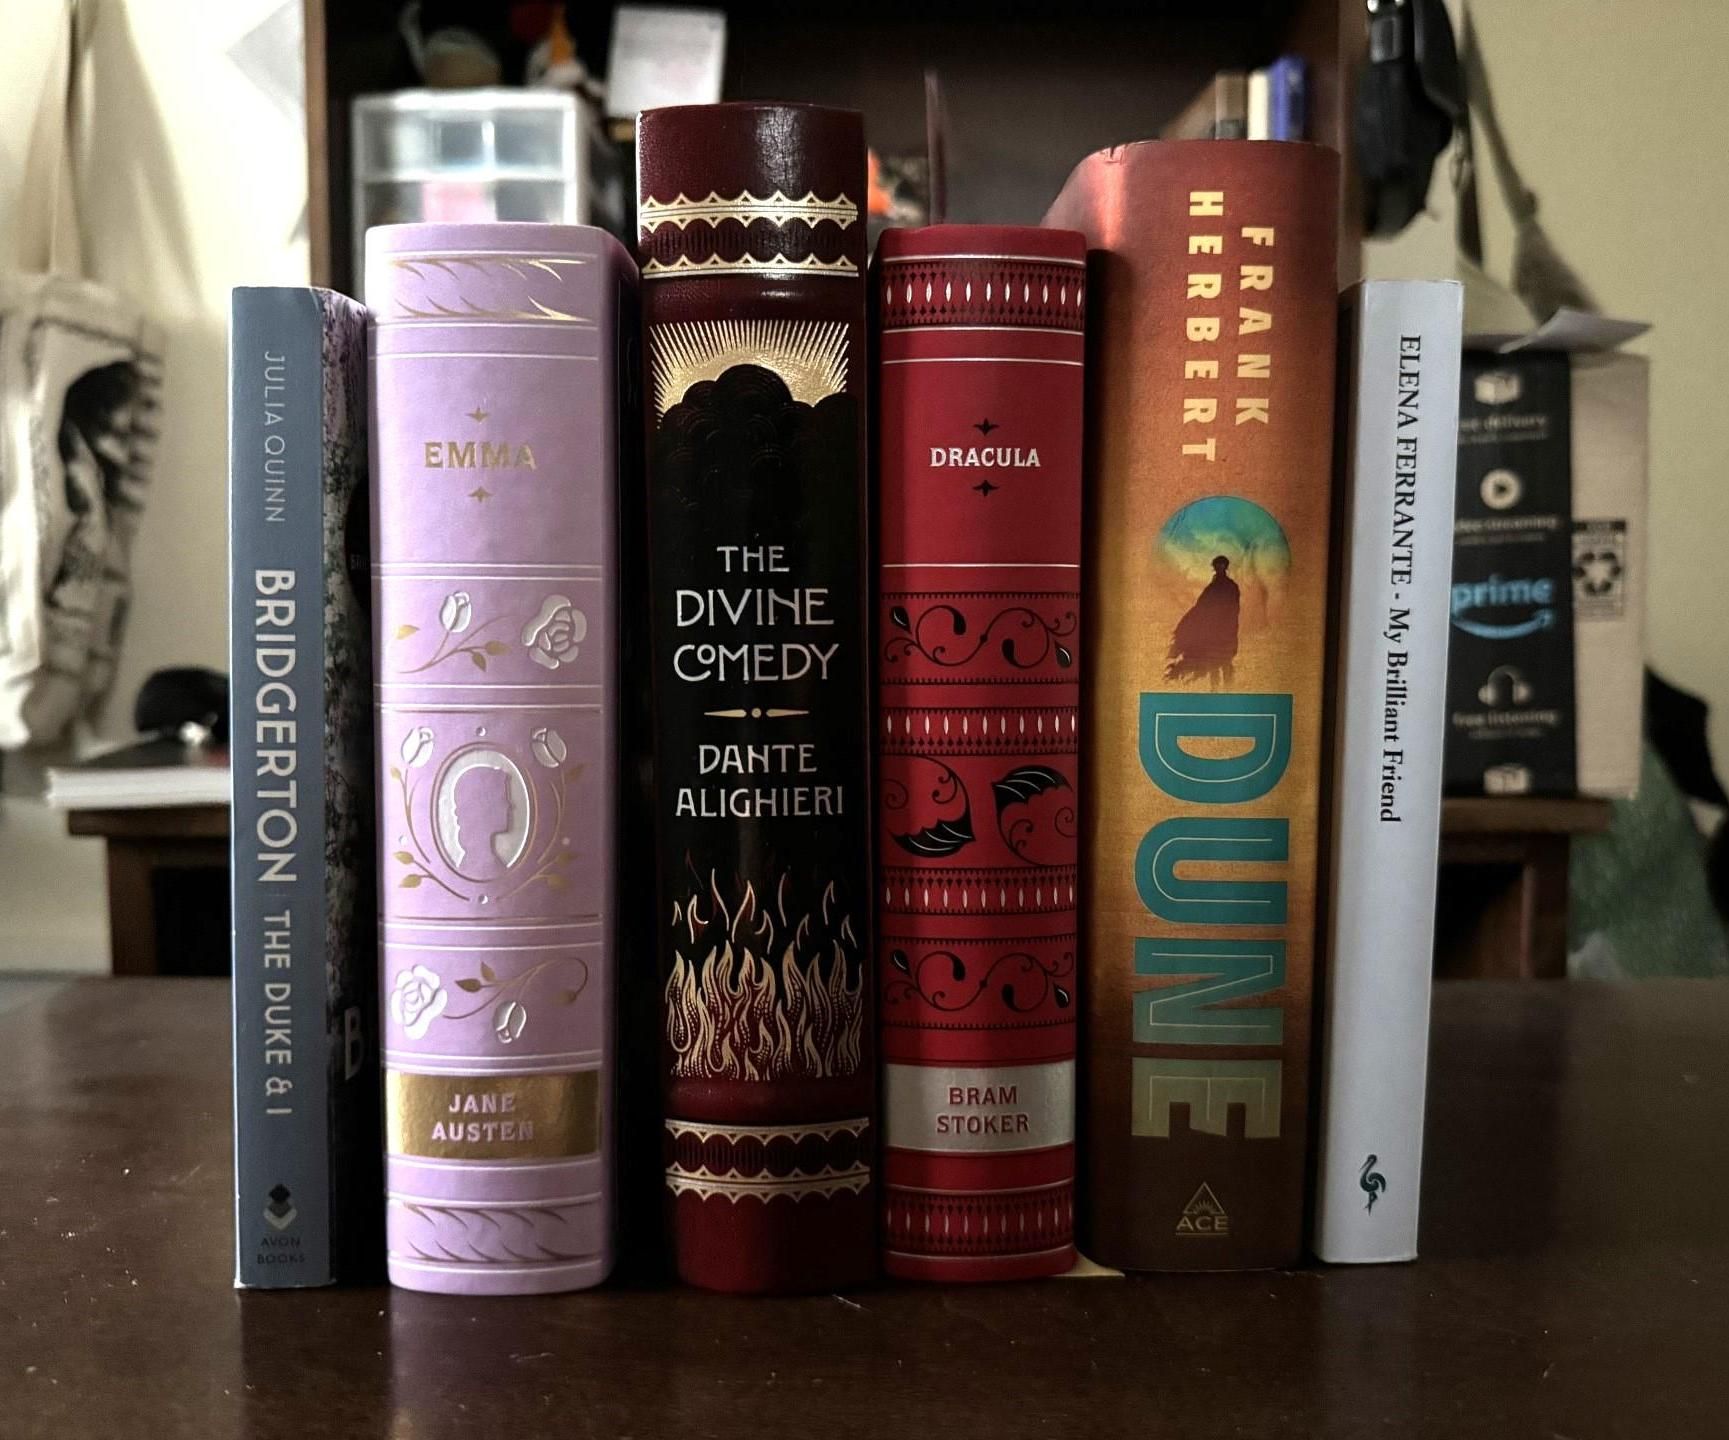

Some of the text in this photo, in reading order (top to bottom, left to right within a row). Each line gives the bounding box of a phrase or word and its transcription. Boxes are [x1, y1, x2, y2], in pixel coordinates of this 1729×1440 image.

[1182, 191, 1224, 462] HERBERT
[1236, 227, 1274, 425] FRANK
[1397, 334, 1421, 429] ELENA
[264, 351, 286, 522] JULIA QUINN
[424, 440, 538, 472] EMMA
[929, 447, 1041, 467] DRACULA
[1391, 436, 1418, 585] FERRANTE
[716, 545, 790, 573] THE
[675, 588, 835, 627] DIVINE
[1452, 574, 1553, 618] prime
[1383, 607, 1410, 644] My
[672, 643, 840, 682] COMEDY
[1384, 650, 1408, 742] Brilliant
[255, 568, 298, 882] BRIDGERTON
[699, 744, 818, 775] DANTE
[674, 785, 843, 818] ALIGHIERI
[1380, 748, 1404, 822] Friend
[1131, 692, 1293, 1138] DUNE
[264, 909, 291, 968] THE
[264, 983, 292, 1065] DUKE
[266, 1076, 293, 1096] &
[449, 1092, 516, 1114] JANE
[949, 1086, 1018, 1105] BRAM
[431, 1121, 535, 1142] AUSTEN
[936, 1113, 1029, 1134] STOKER
[260, 1236, 301, 1249] AVON
[1176, 1215, 1230, 1232] ACE
[257, 1252, 306, 1265] BOOKS
